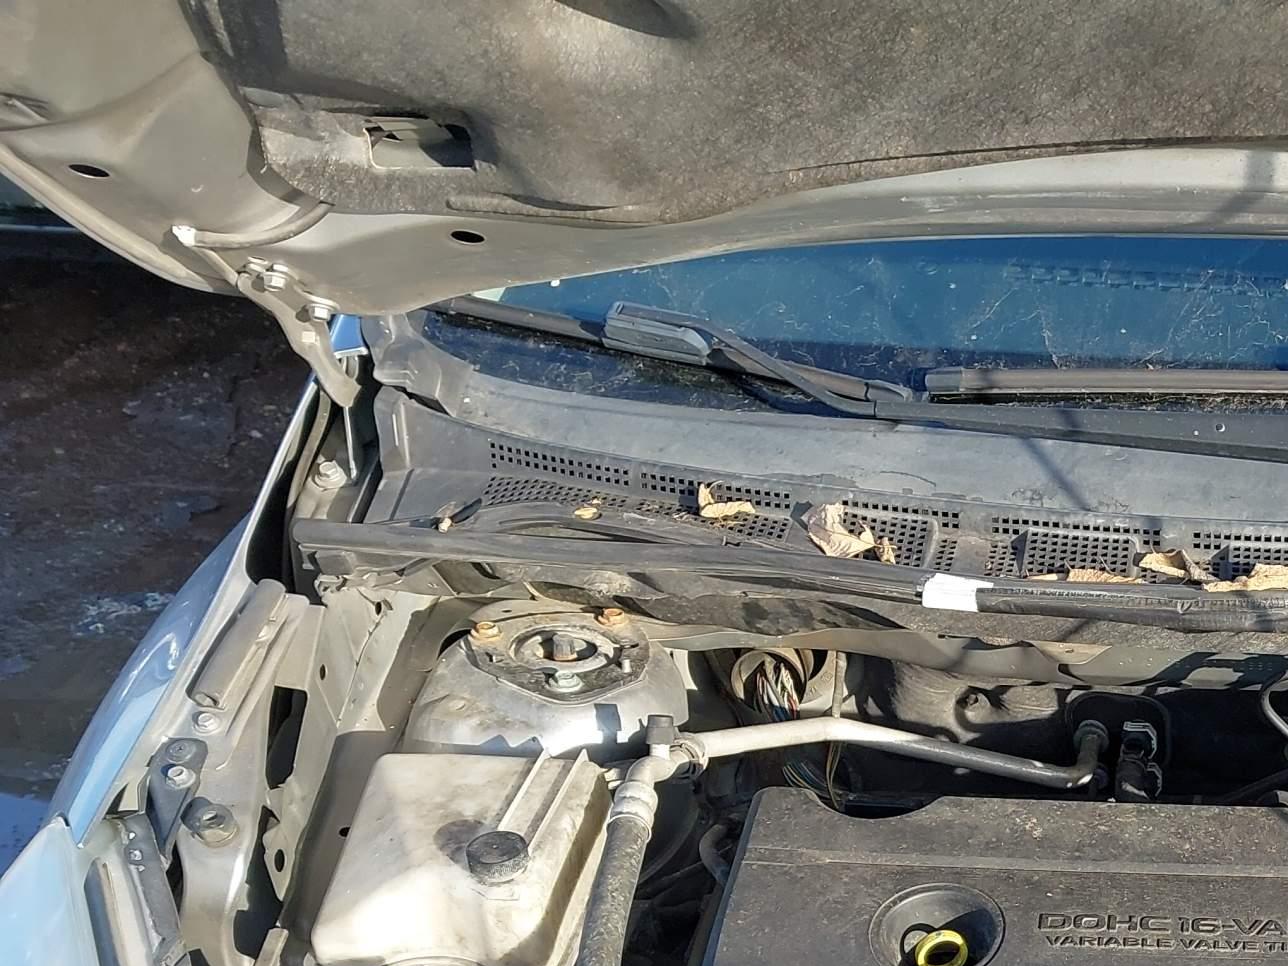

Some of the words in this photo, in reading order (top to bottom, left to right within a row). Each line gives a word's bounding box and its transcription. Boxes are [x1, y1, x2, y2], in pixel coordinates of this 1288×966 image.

[1037, 912, 1172, 932] DOHC
[1045, 934, 1173, 949] VARIABLE
[1178, 938, 1261, 952] VALVE
